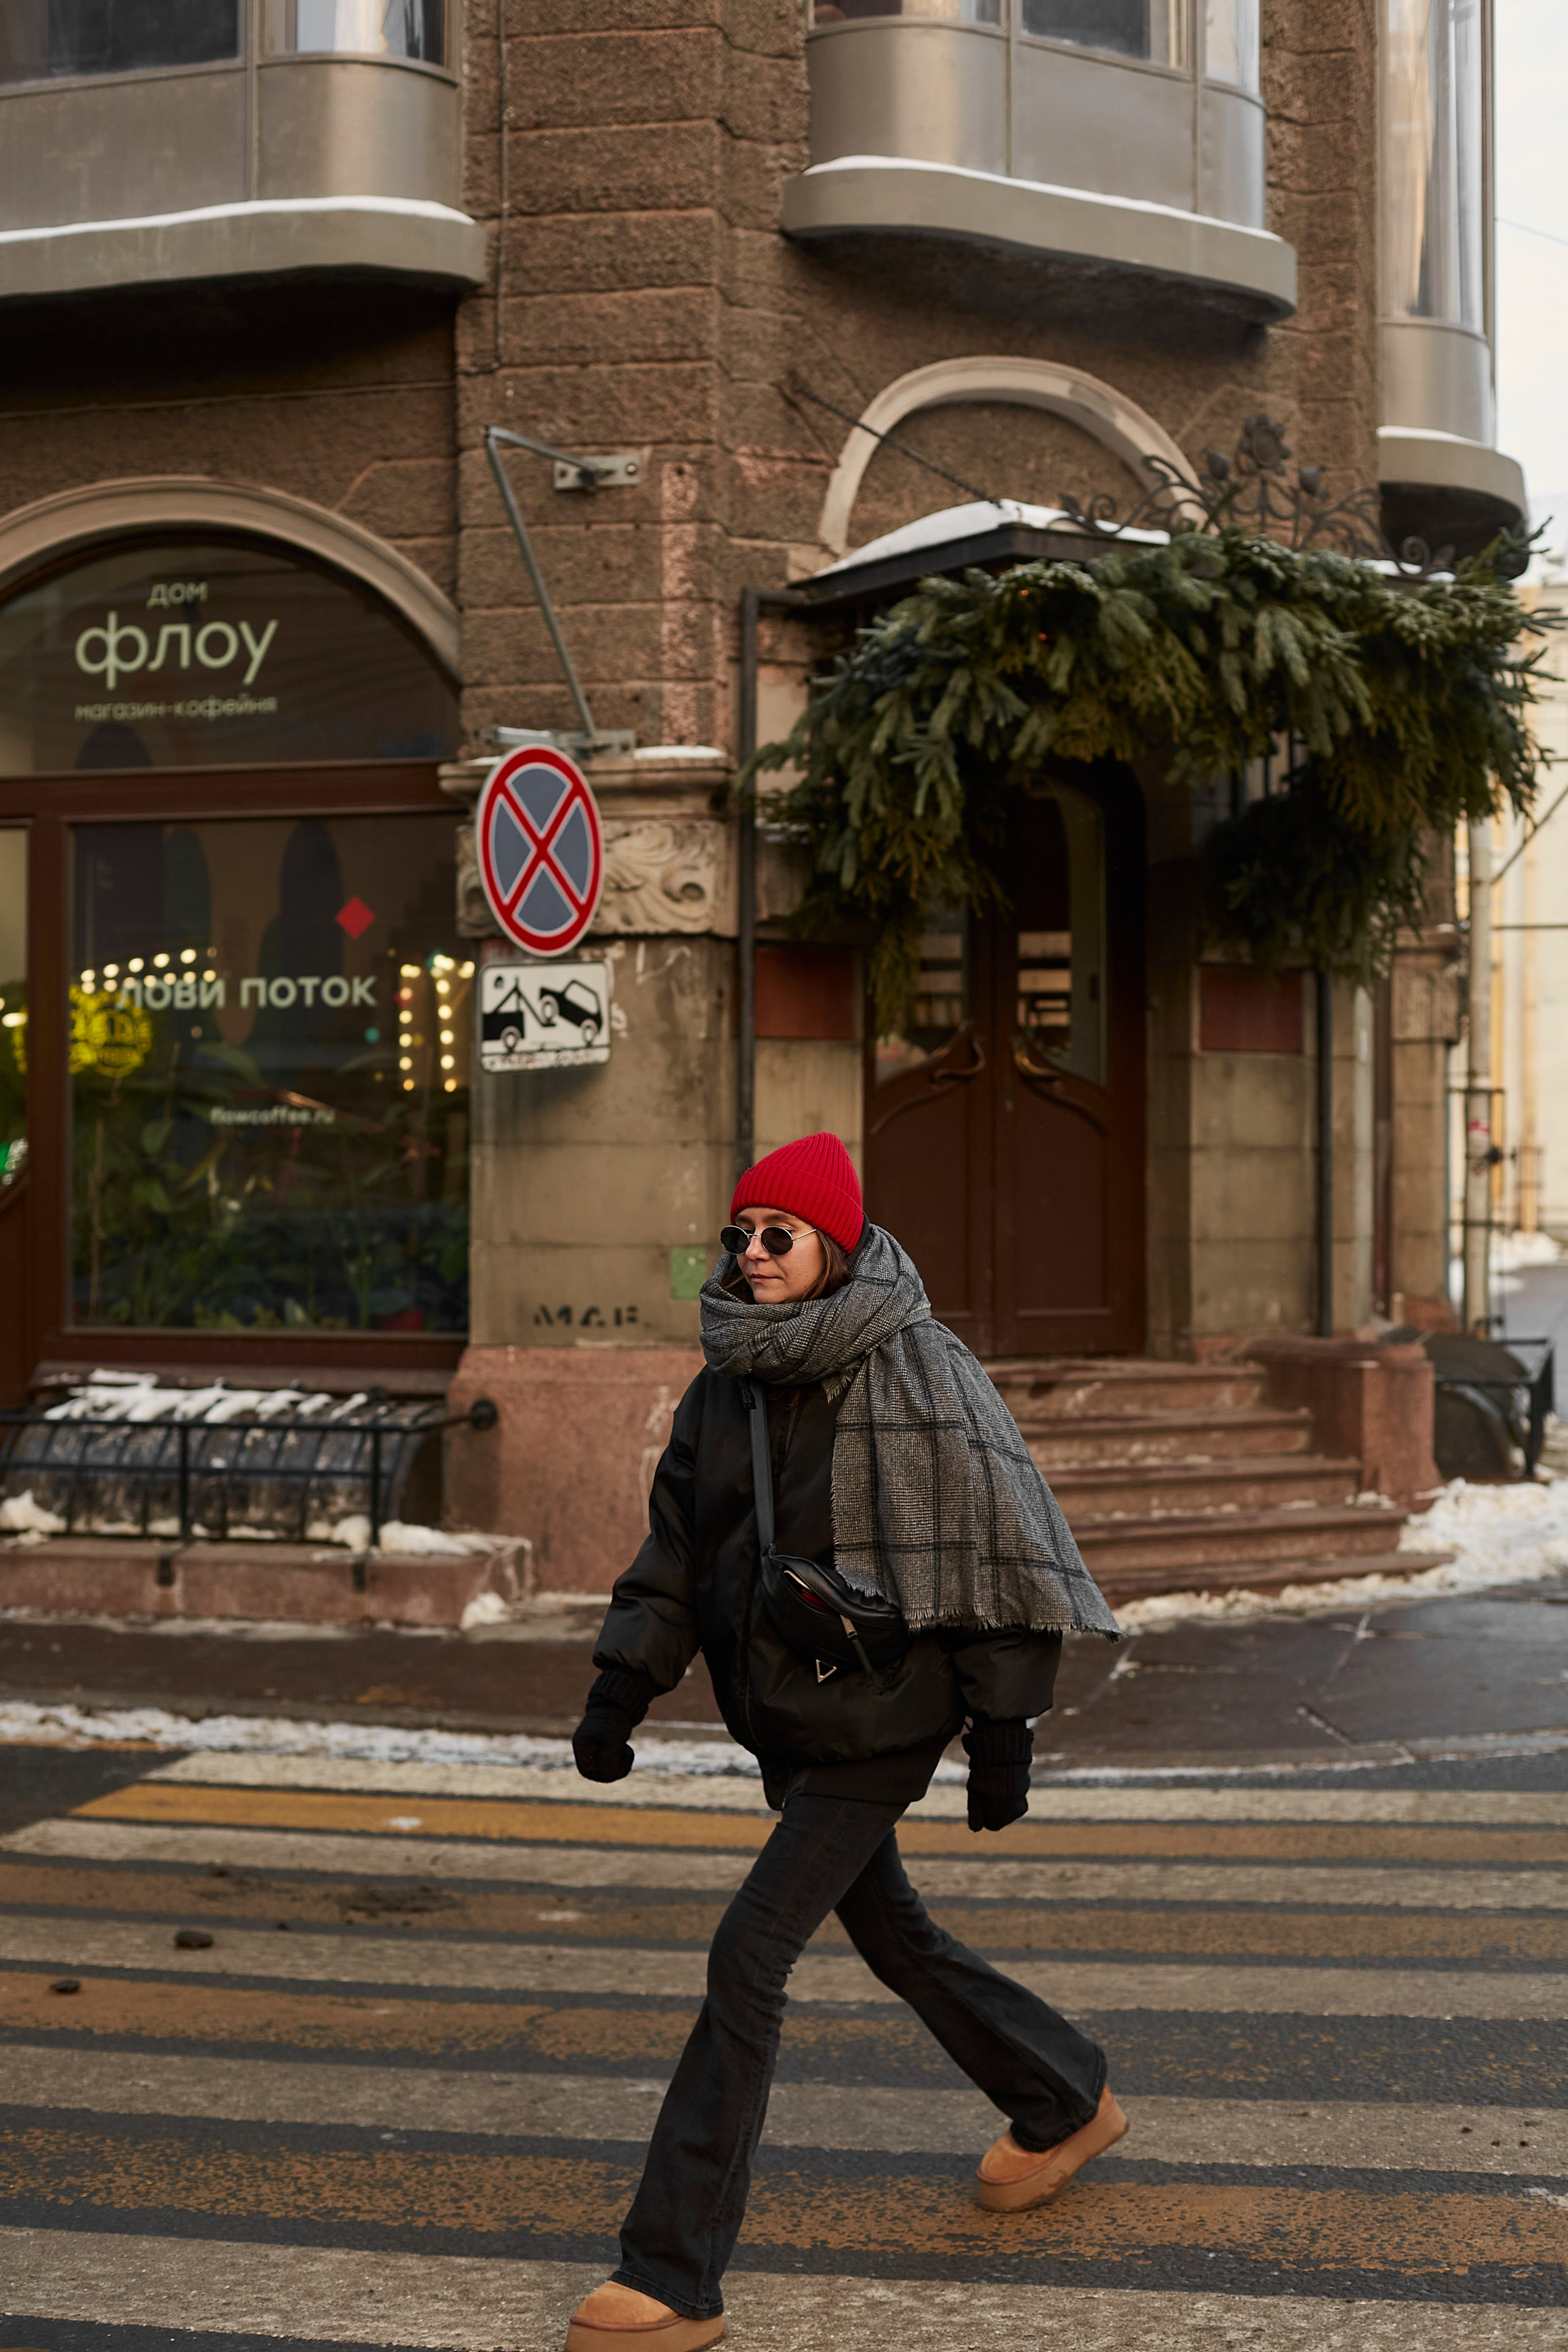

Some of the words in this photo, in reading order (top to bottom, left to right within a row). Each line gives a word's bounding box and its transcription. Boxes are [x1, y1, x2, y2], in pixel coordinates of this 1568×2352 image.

[75, 611, 278, 690] флоу
[75, 694, 277, 721] магазин-кофейня
[211, 1106, 334, 1125] flowcoffee.ru
